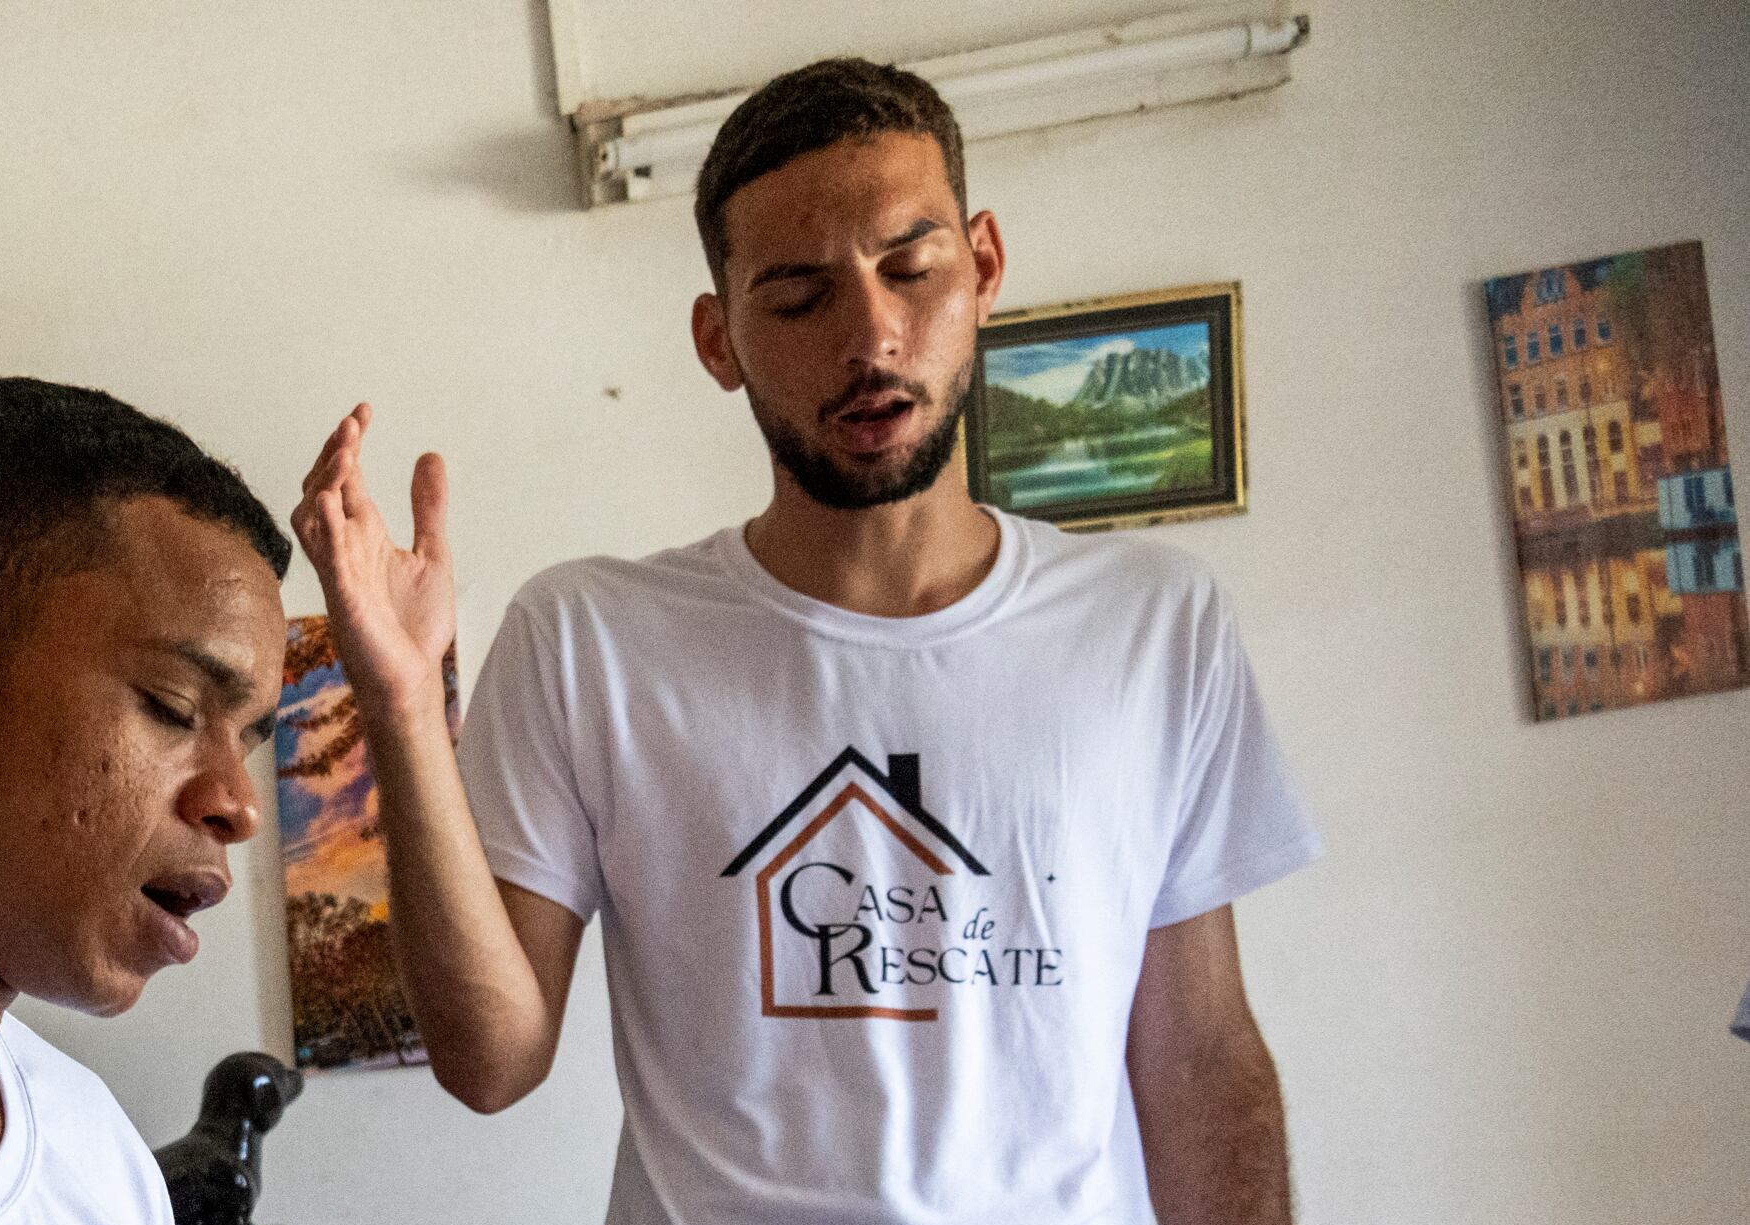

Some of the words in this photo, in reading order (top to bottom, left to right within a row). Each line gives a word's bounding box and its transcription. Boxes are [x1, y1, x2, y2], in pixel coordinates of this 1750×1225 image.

[780, 862, 951, 939] CASA
[963, 907, 995, 940] de
[814, 924, 1064, 995] RESCATE
